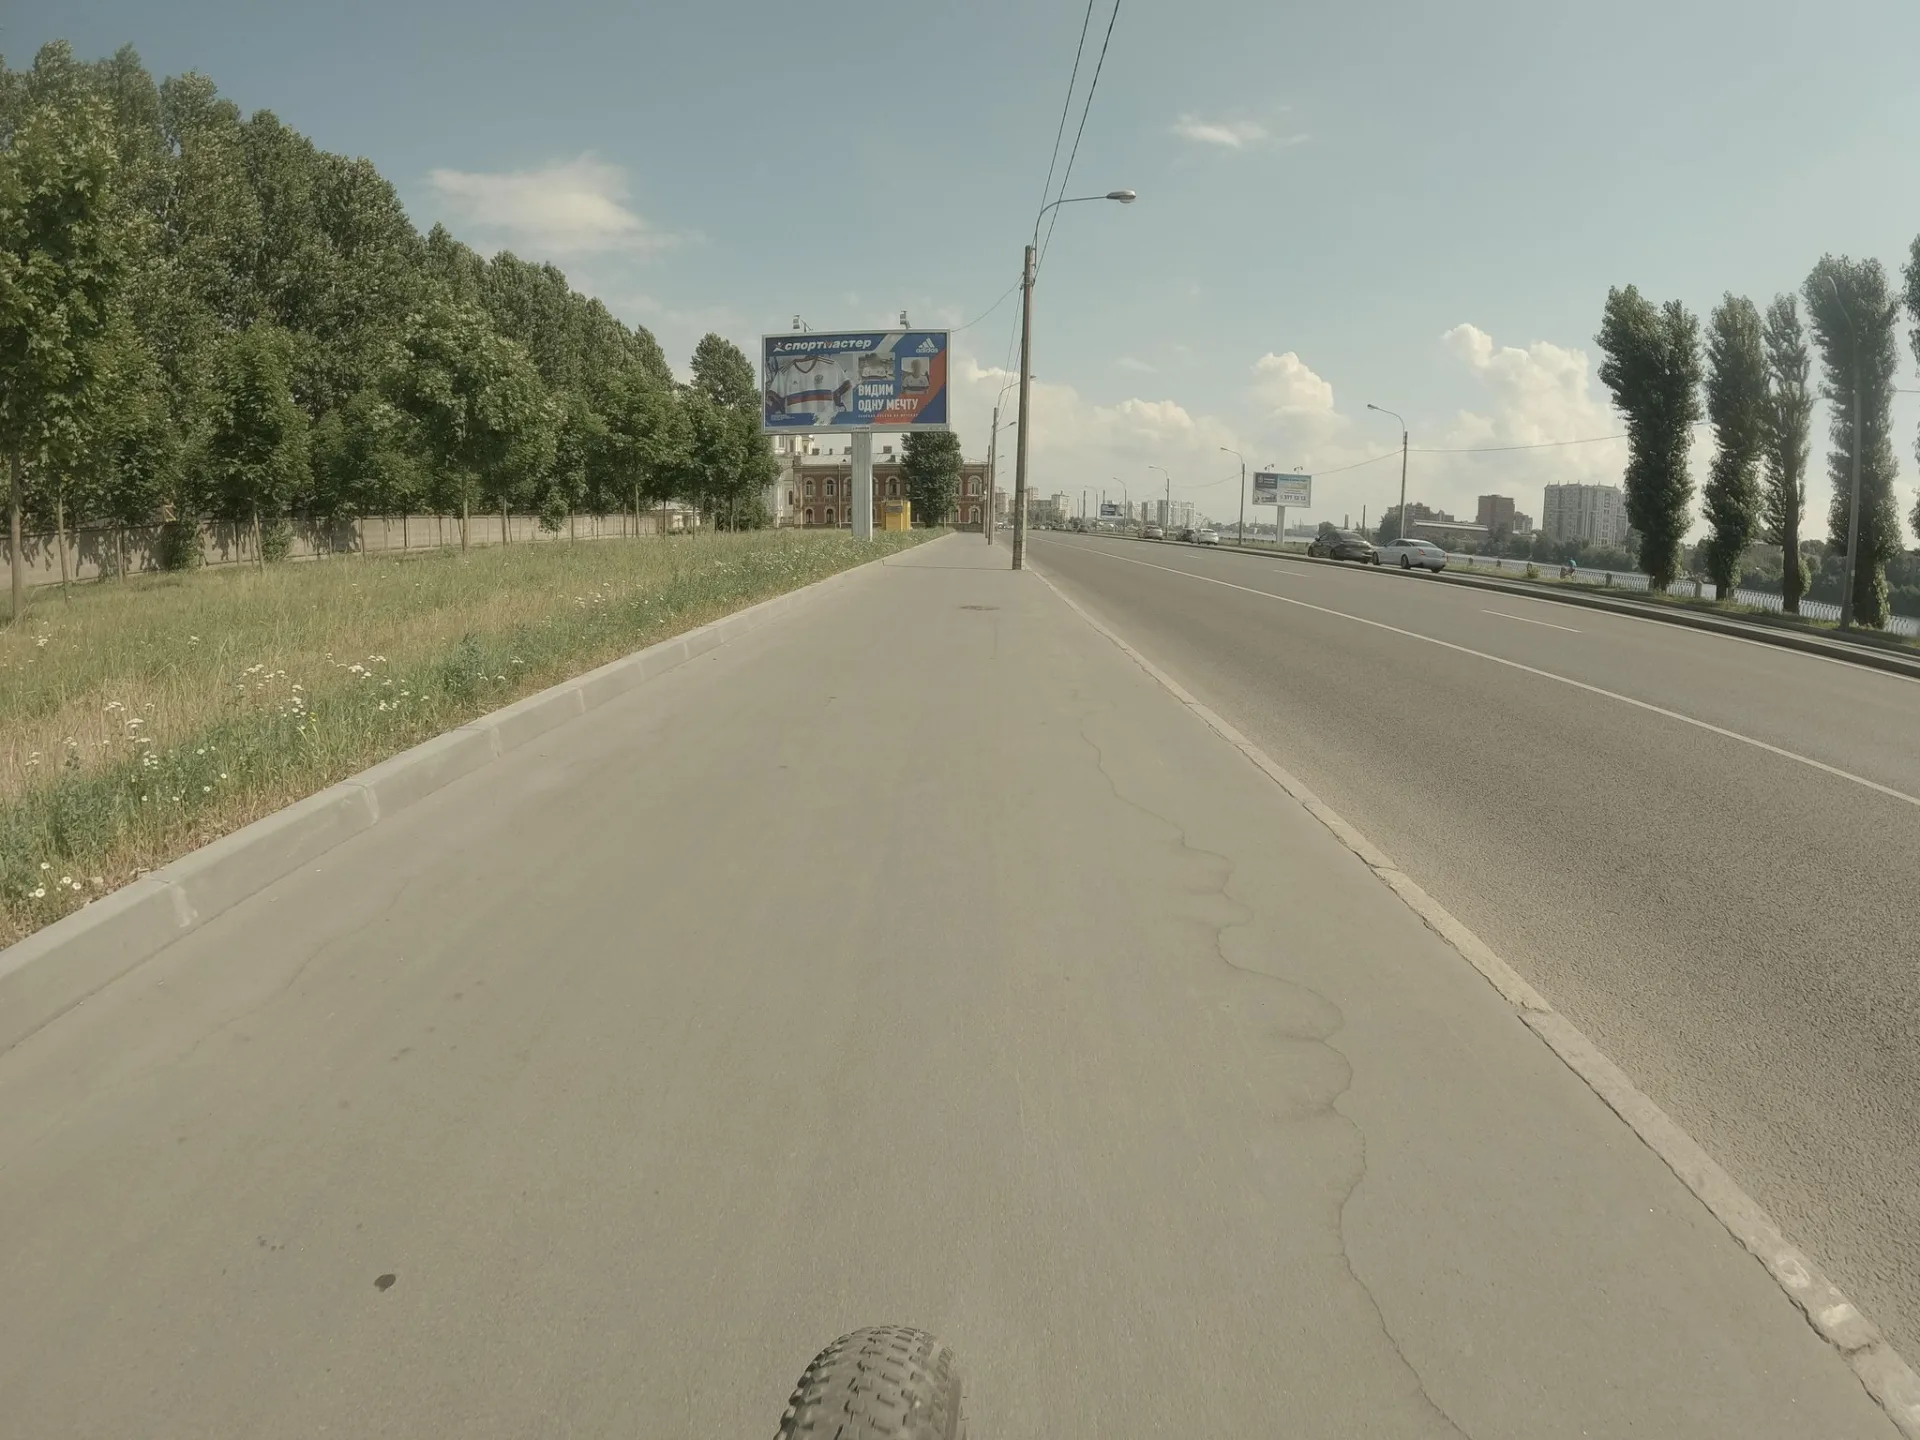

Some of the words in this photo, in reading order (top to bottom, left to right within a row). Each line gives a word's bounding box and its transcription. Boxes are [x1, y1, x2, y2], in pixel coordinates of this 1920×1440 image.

[784, 339, 872, 351] спортмастер
[858, 384, 894, 397] ВИДИМ
[858, 399, 884, 412] ОДНУ
[886, 398, 919, 411] МЕЧТУ
